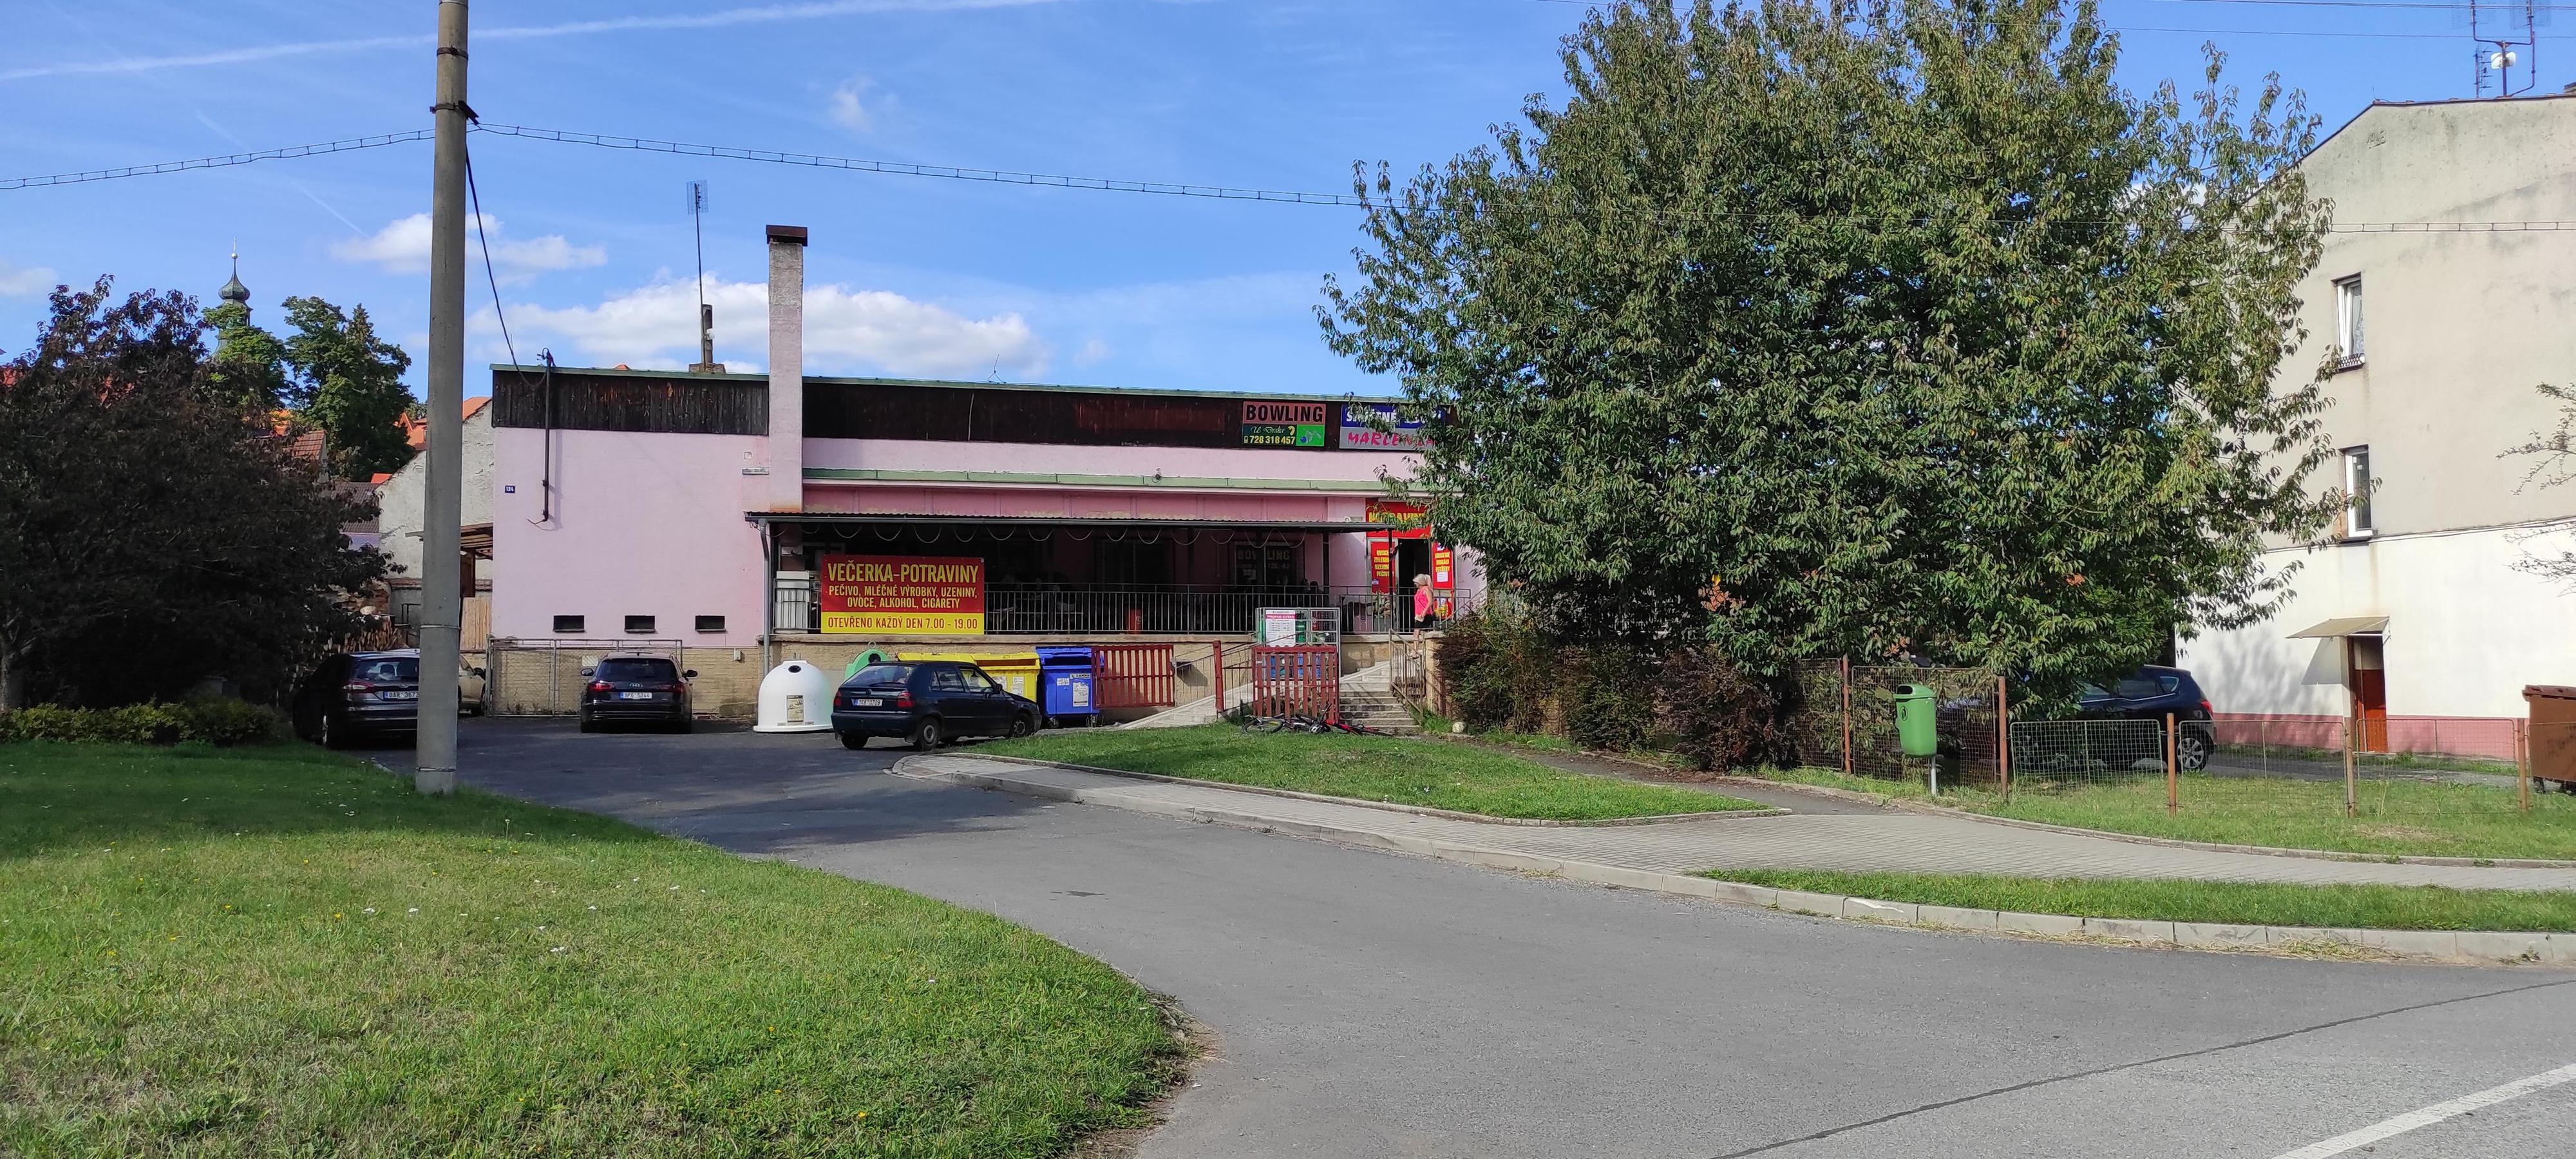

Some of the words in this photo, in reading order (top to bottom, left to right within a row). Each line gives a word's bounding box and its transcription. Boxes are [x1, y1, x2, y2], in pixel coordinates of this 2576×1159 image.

[1246, 404, 1323, 423] BOWLING
[1249, 436, 1264, 444] 728
[1265, 436, 1280, 444] 318
[1281, 436, 1295, 445] 457
[828, 560, 979, 583] VEČERKA-POTRAVINY
[829, 584, 861, 597] PEČIVO,
[864, 584, 897, 597] MLÉČNÉ
[900, 584, 938, 598] VÝROBKY,
[941, 587, 978, 599] UZENINY,
[848, 597, 876, 609] OVOCE,
[880, 597, 918, 609] ALKOHOL,
[922, 598, 960, 608] CIGARETY
[828, 616, 871, 628] OTEVŘENO
[876, 616, 903, 628] KAŽDÝ
[906, 618, 922, 629] DEN
[926, 618, 944, 629] 7.00
[954, 619, 978, 629] 19.00
